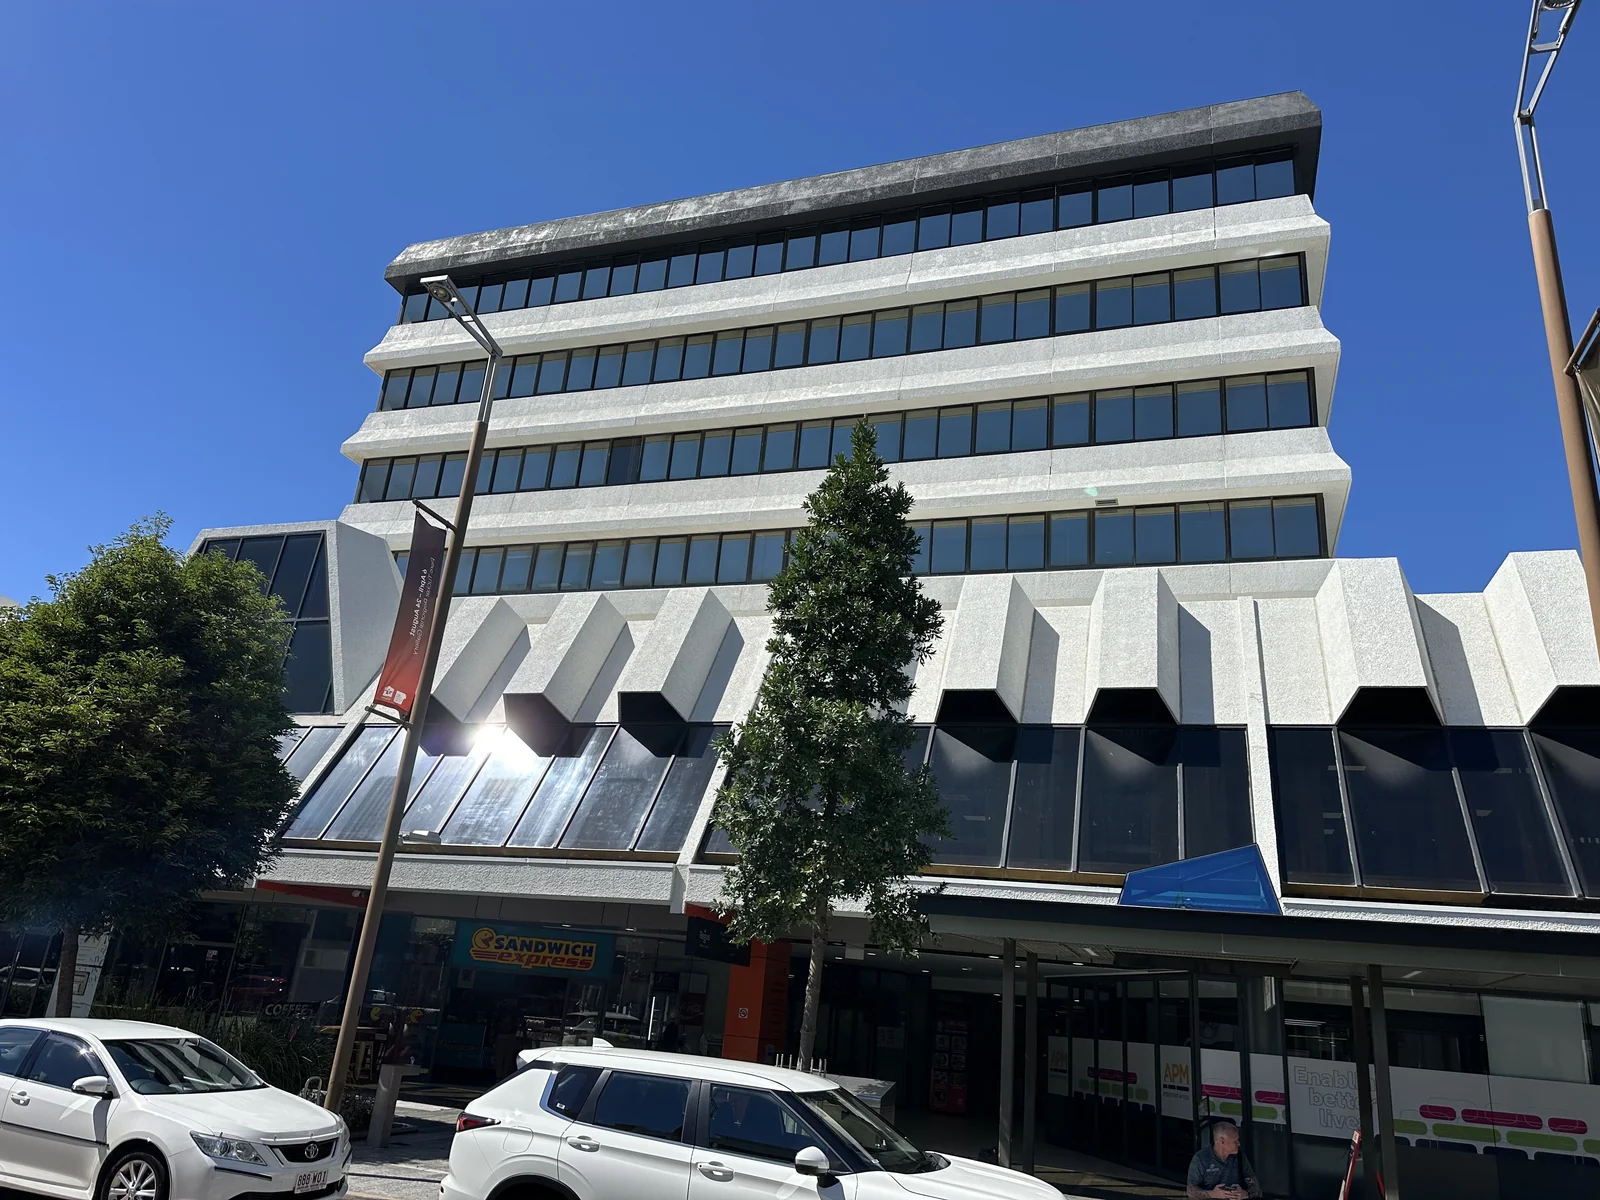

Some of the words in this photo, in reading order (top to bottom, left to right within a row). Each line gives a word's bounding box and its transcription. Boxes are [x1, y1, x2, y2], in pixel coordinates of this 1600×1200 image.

[494, 937, 594, 957] SANDWICH
[497, 951, 594, 969] express
[264, 1003, 309, 1016] COFFEE
[1163, 1062, 1190, 1085] APM
[1293, 1065, 1376, 1092] Enabl
[1318, 1108, 1361, 1130] live
